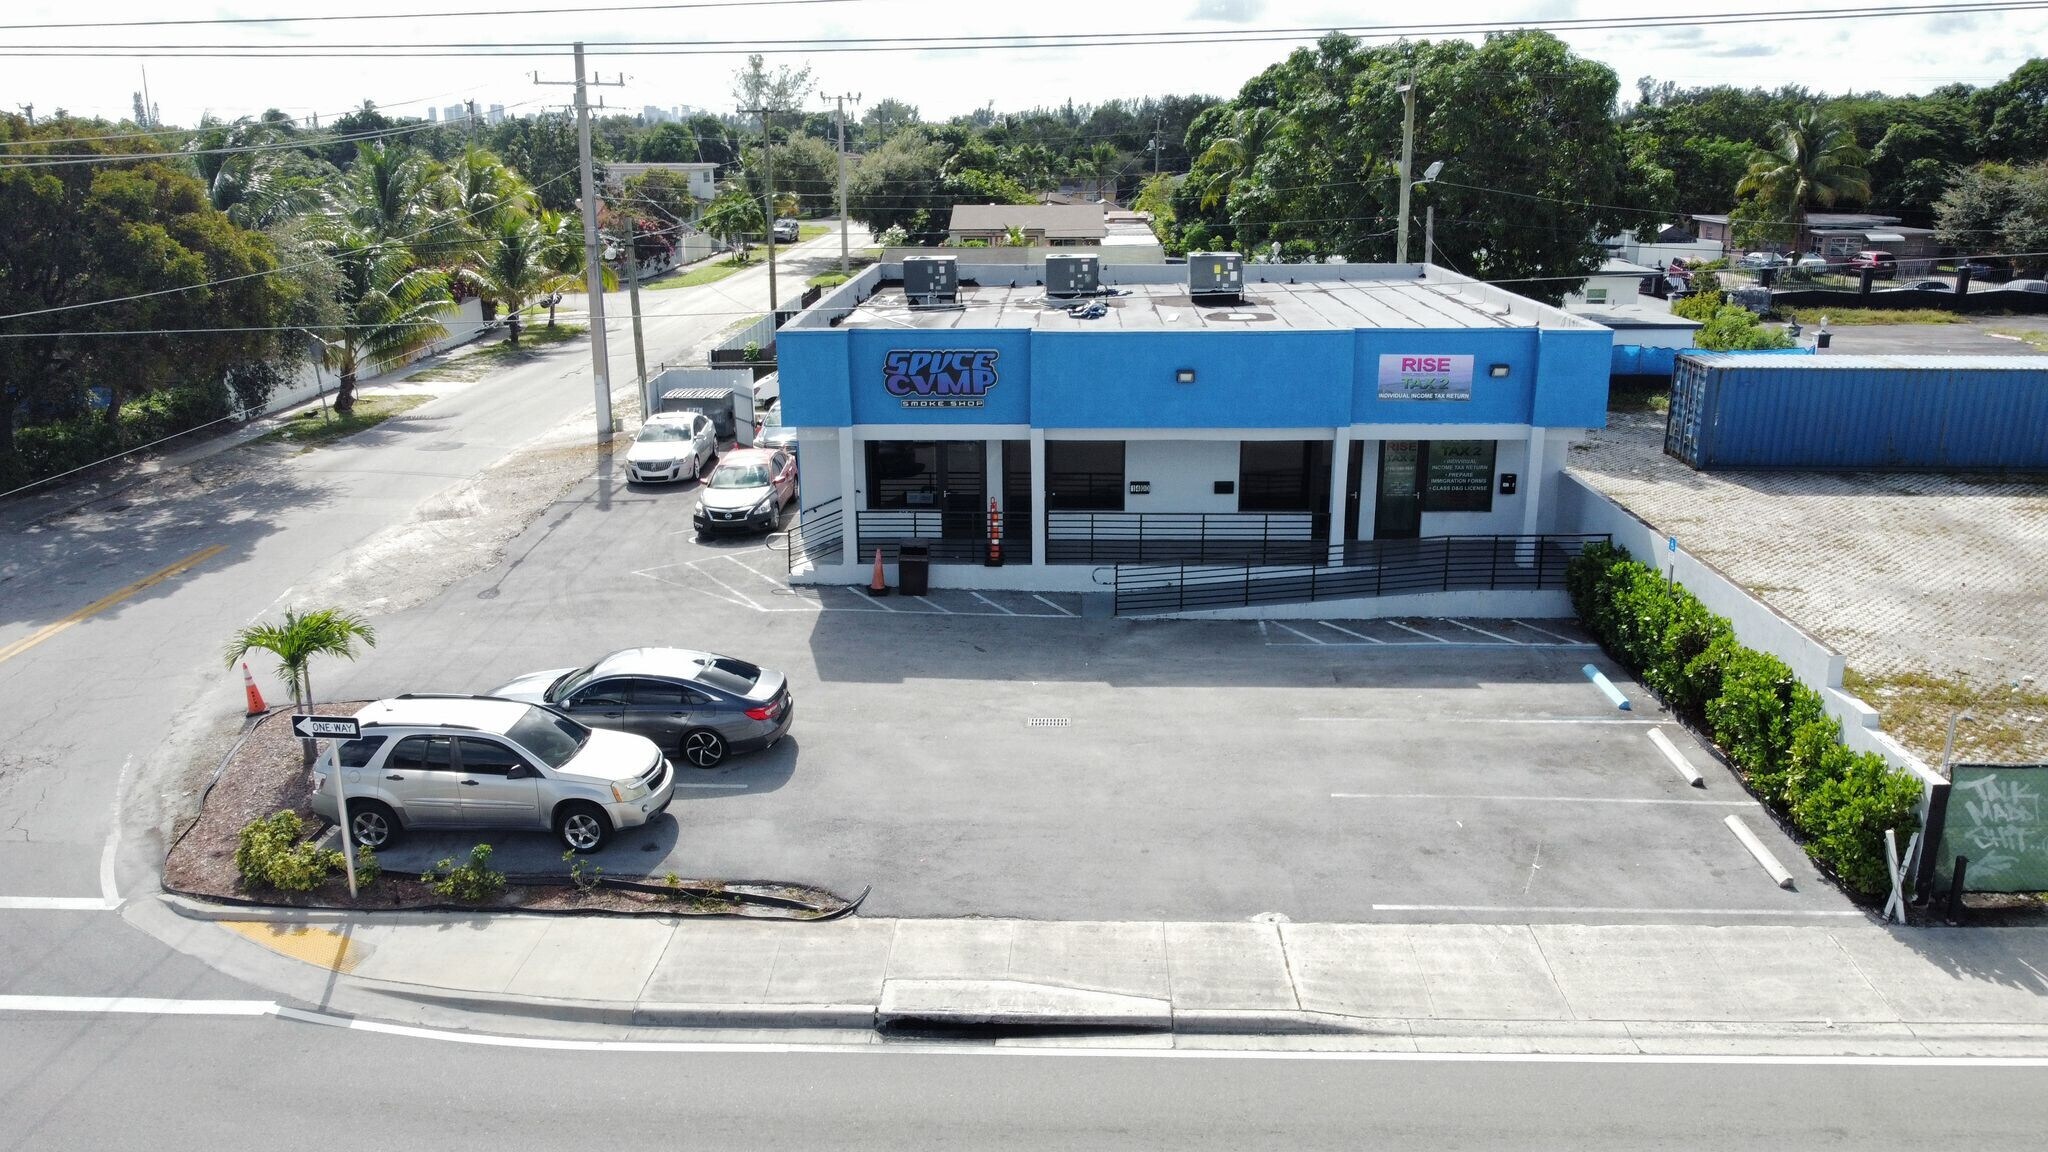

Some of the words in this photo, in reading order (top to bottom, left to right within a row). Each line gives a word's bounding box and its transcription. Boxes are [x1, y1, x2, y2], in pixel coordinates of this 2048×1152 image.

[1401, 357, 1451, 373] RISE
[1401, 377, 1436, 390] TAX
[1439, 377, 1450, 390] 2
[1386, 442, 1416, 452] RISE
[1442, 446, 1471, 456] TAX
[1472, 446, 1482, 456] 2
[312, 722, 331, 732] ONE
[333, 723, 352, 733] WAY
